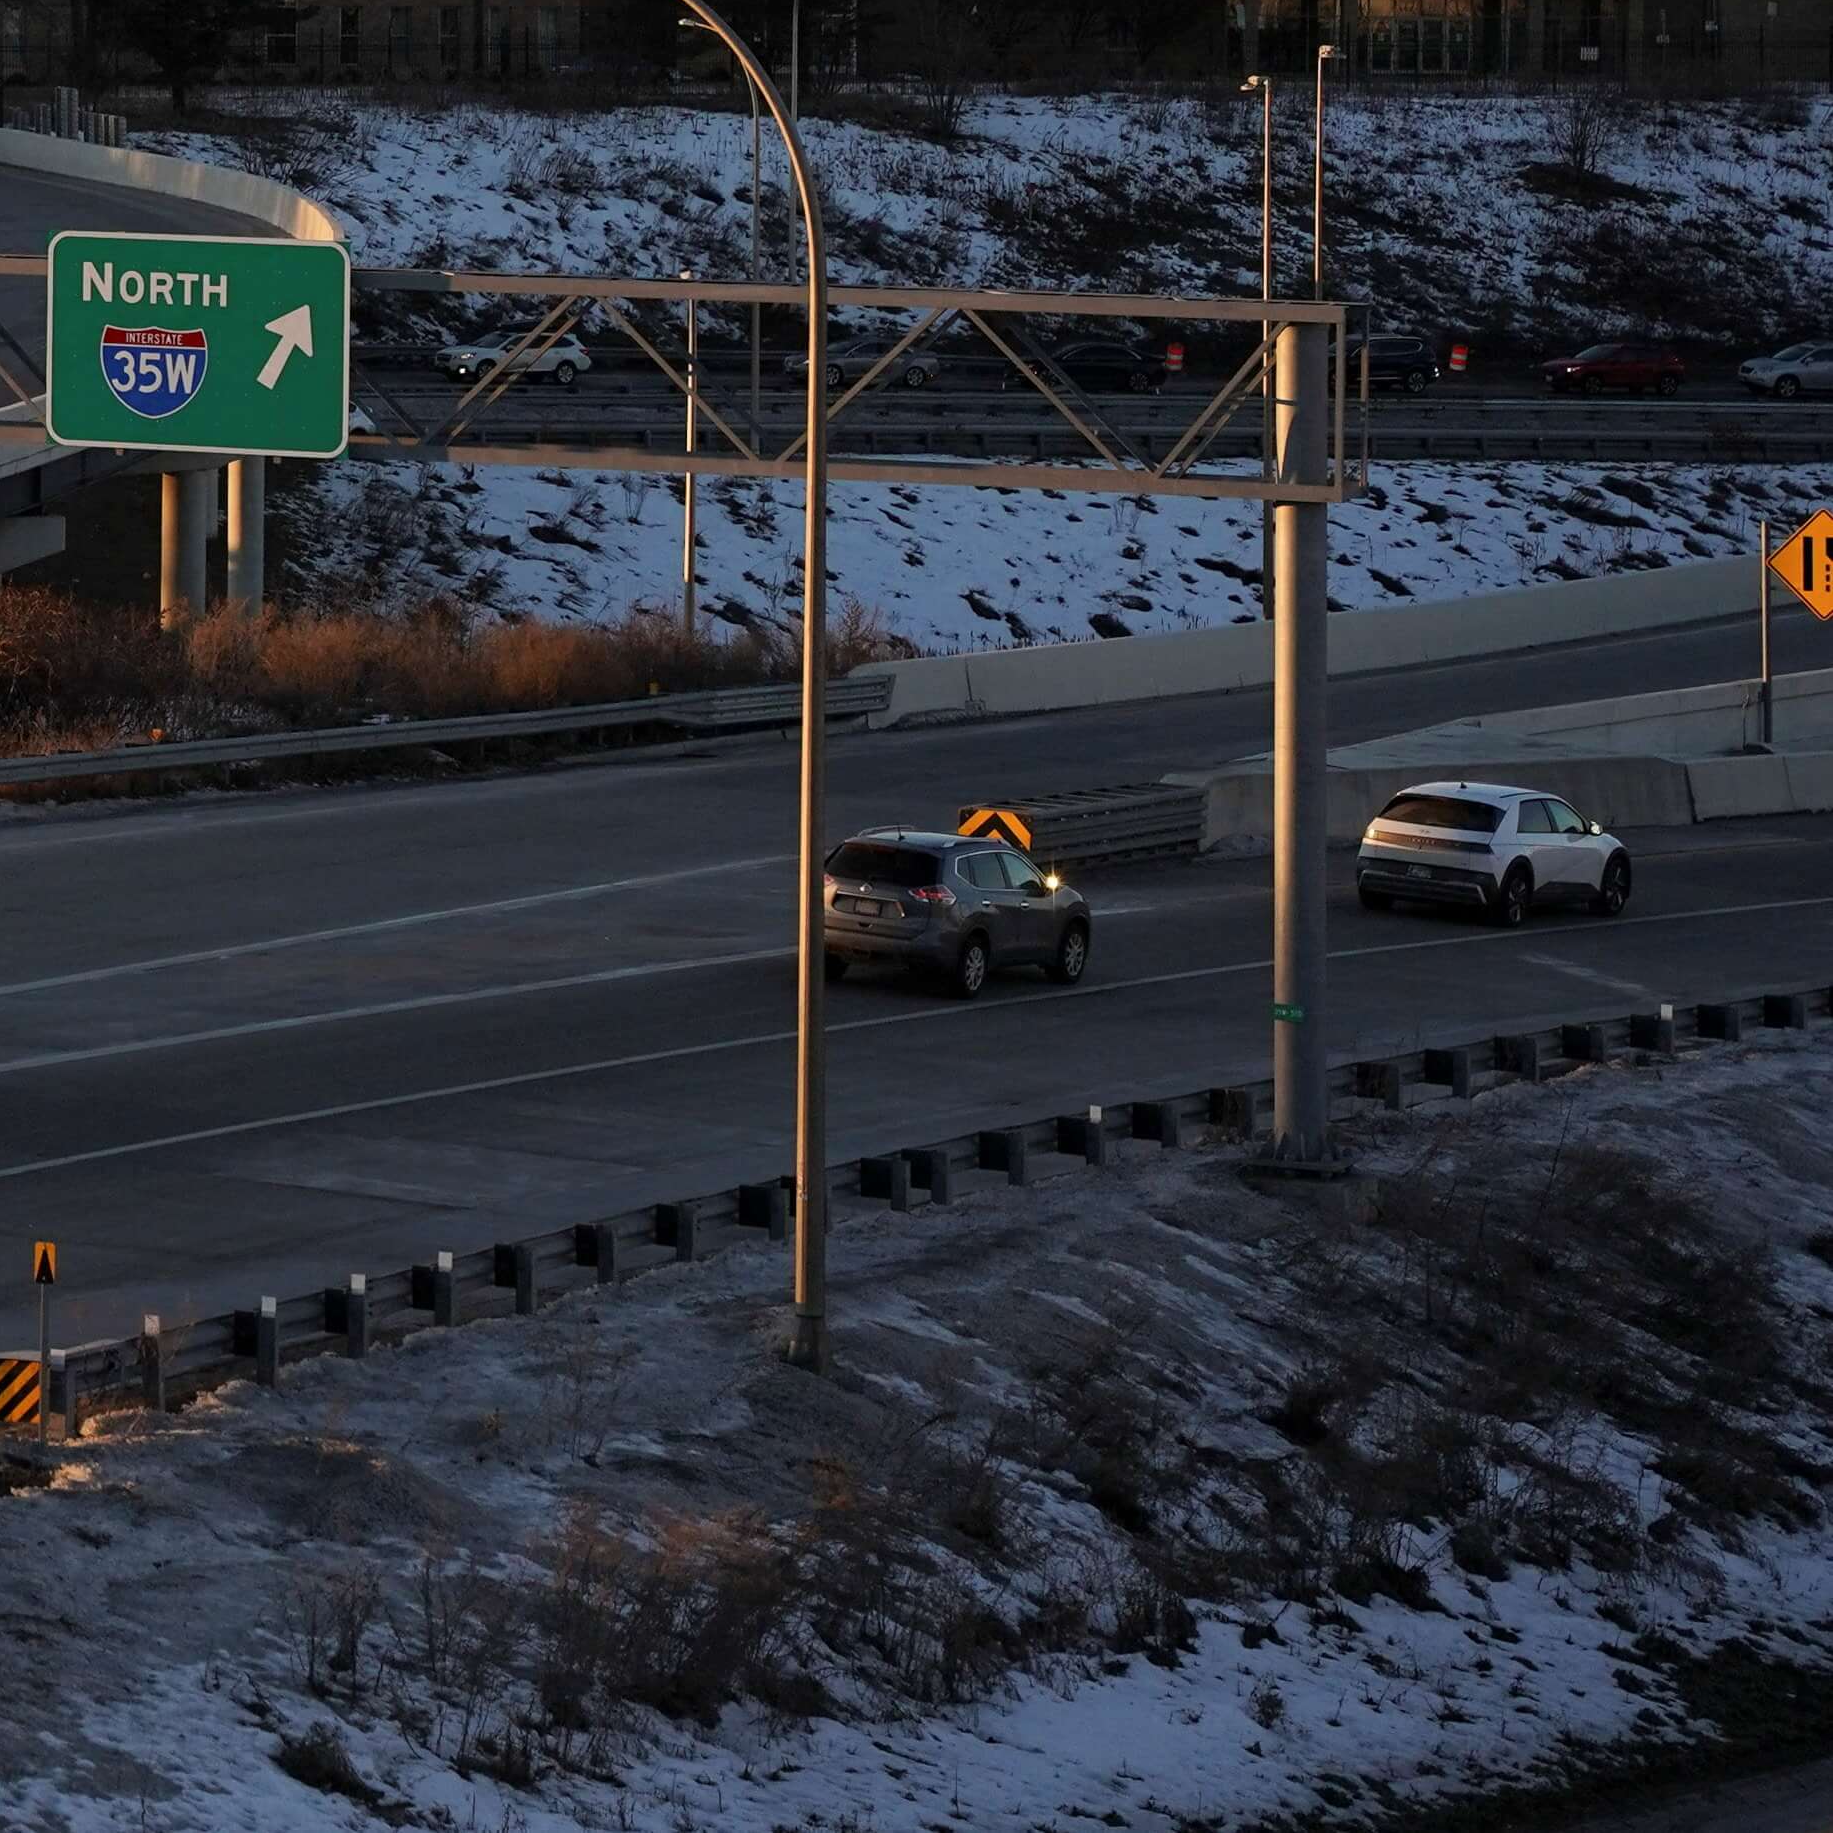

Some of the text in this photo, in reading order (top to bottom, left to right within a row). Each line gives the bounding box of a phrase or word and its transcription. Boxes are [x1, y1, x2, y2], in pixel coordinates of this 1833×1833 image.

[83, 261, 228, 308] NORTH
[125, 332, 184, 346] INTERSTATE
[111, 350, 197, 395] 35W
